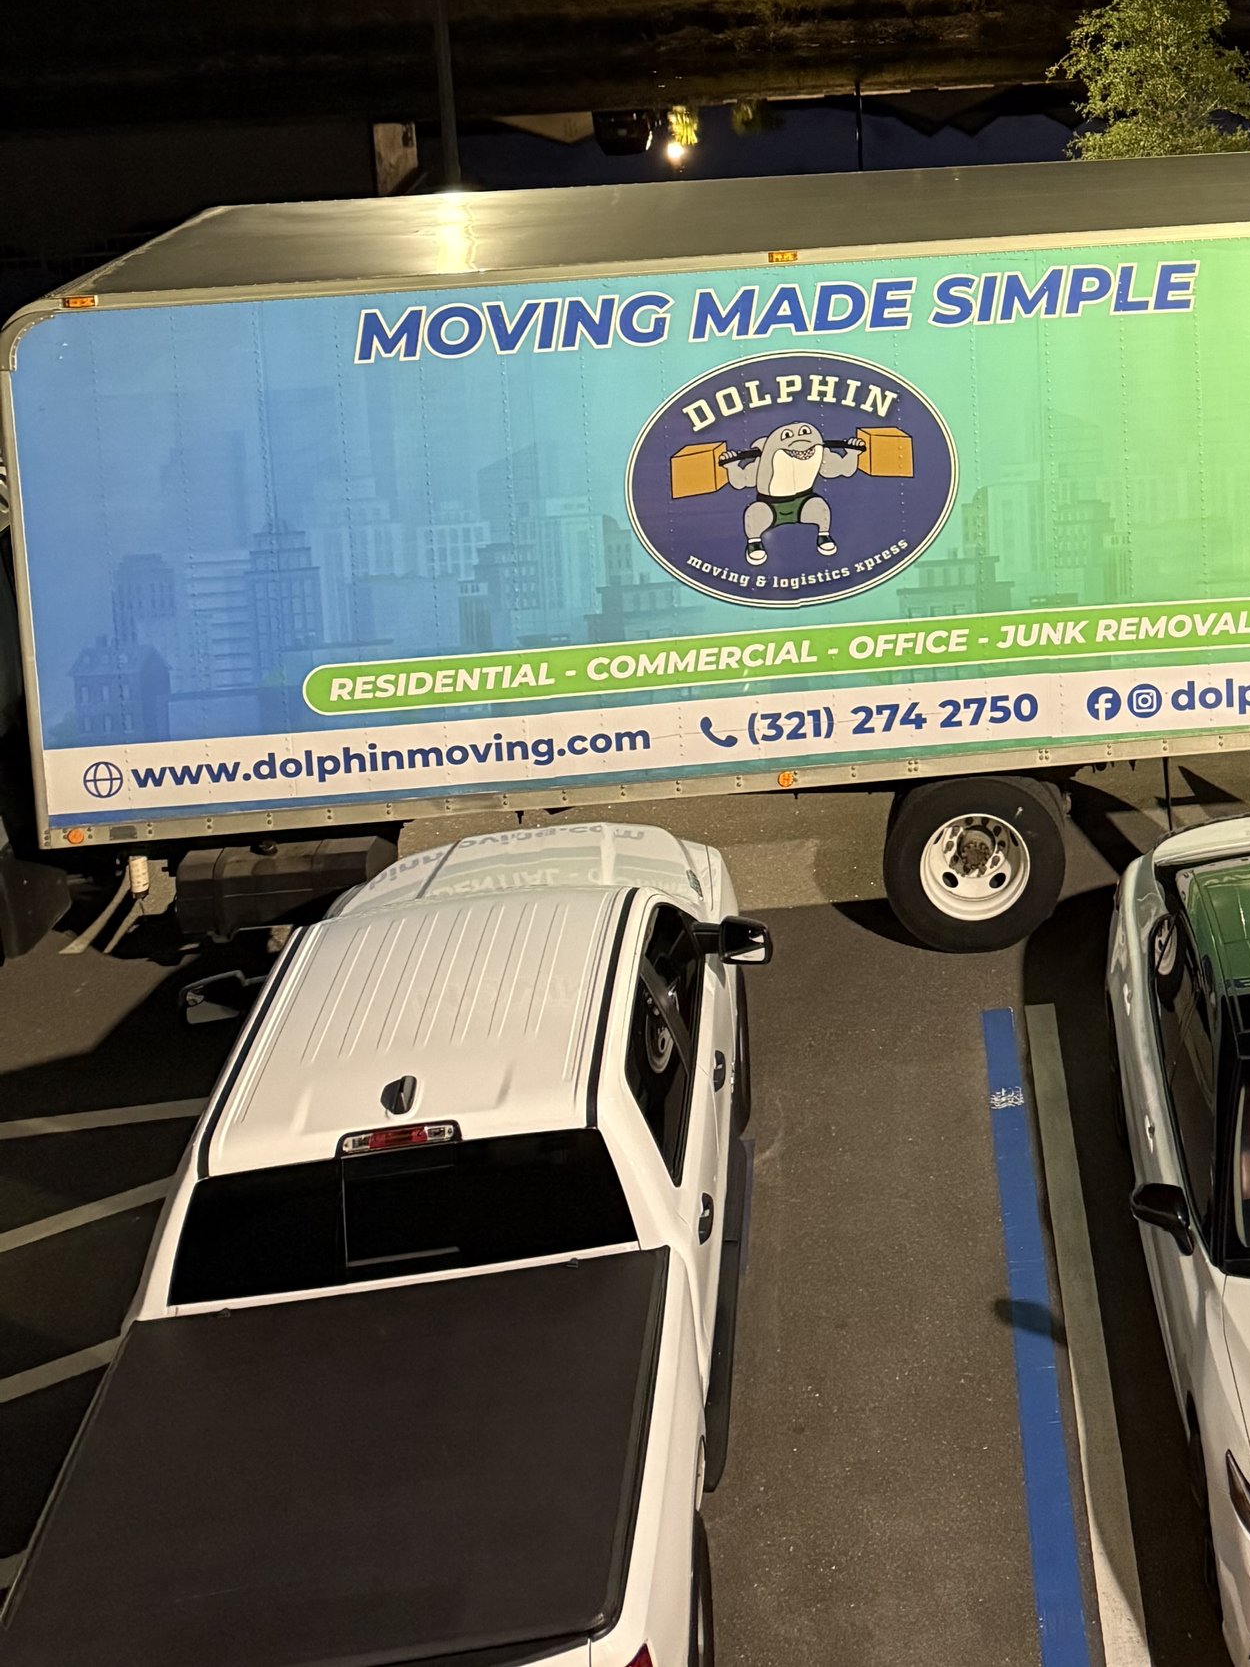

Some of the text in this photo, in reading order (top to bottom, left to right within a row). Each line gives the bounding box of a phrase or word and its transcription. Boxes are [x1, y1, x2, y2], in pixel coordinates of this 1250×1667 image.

[354, 260, 1200, 364] MOVING MADE SIMPLE
[682, 375, 898, 432] DOLPHIN
[687, 539, 908, 589] moving & logistics xpress
[330, 662, 555, 701] RESIDENTIAL
[586, 640, 817, 681] COMMERCIAL
[848, 628, 970, 660] OFFICE
[996, 620, 1087, 650] JUNK
[748, 693, 1039, 745] (321) 274 2750
[130, 729, 651, 788] www.dolphinmoving.com
